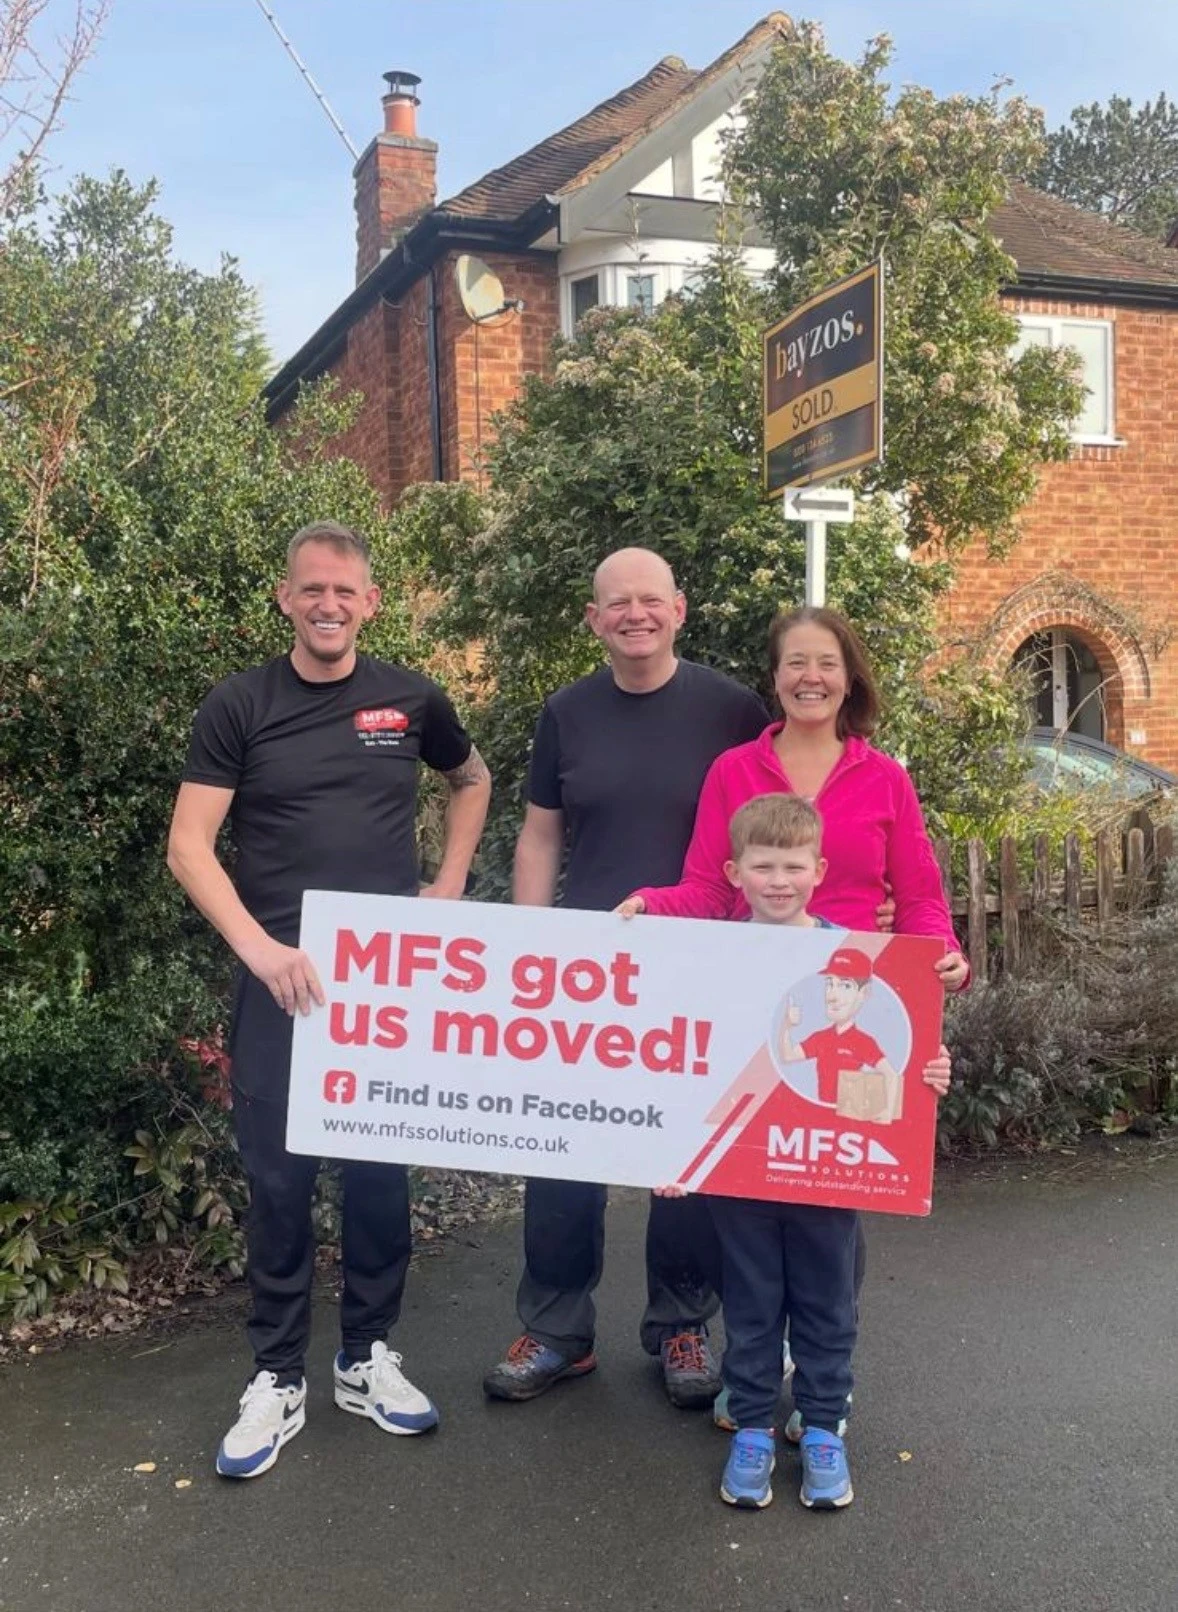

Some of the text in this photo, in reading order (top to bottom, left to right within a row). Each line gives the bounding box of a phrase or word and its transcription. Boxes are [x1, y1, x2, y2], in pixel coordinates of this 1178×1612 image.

[776, 309, 864, 379] bayzos.
[361, 710, 394, 723] MFS
[333, 928, 640, 1009] MFS got
[329, 1002, 713, 1075] us moved!
[367, 1080, 665, 1129] Find us on Facebook
[323, 1117, 570, 1154] www.mfssolutions.co.uk
[767, 1124, 864, 1166] MFS
[765, 1173, 907, 1196] Delivering outstanding service
[811, 1165, 910, 1183] SOLUTIONS
